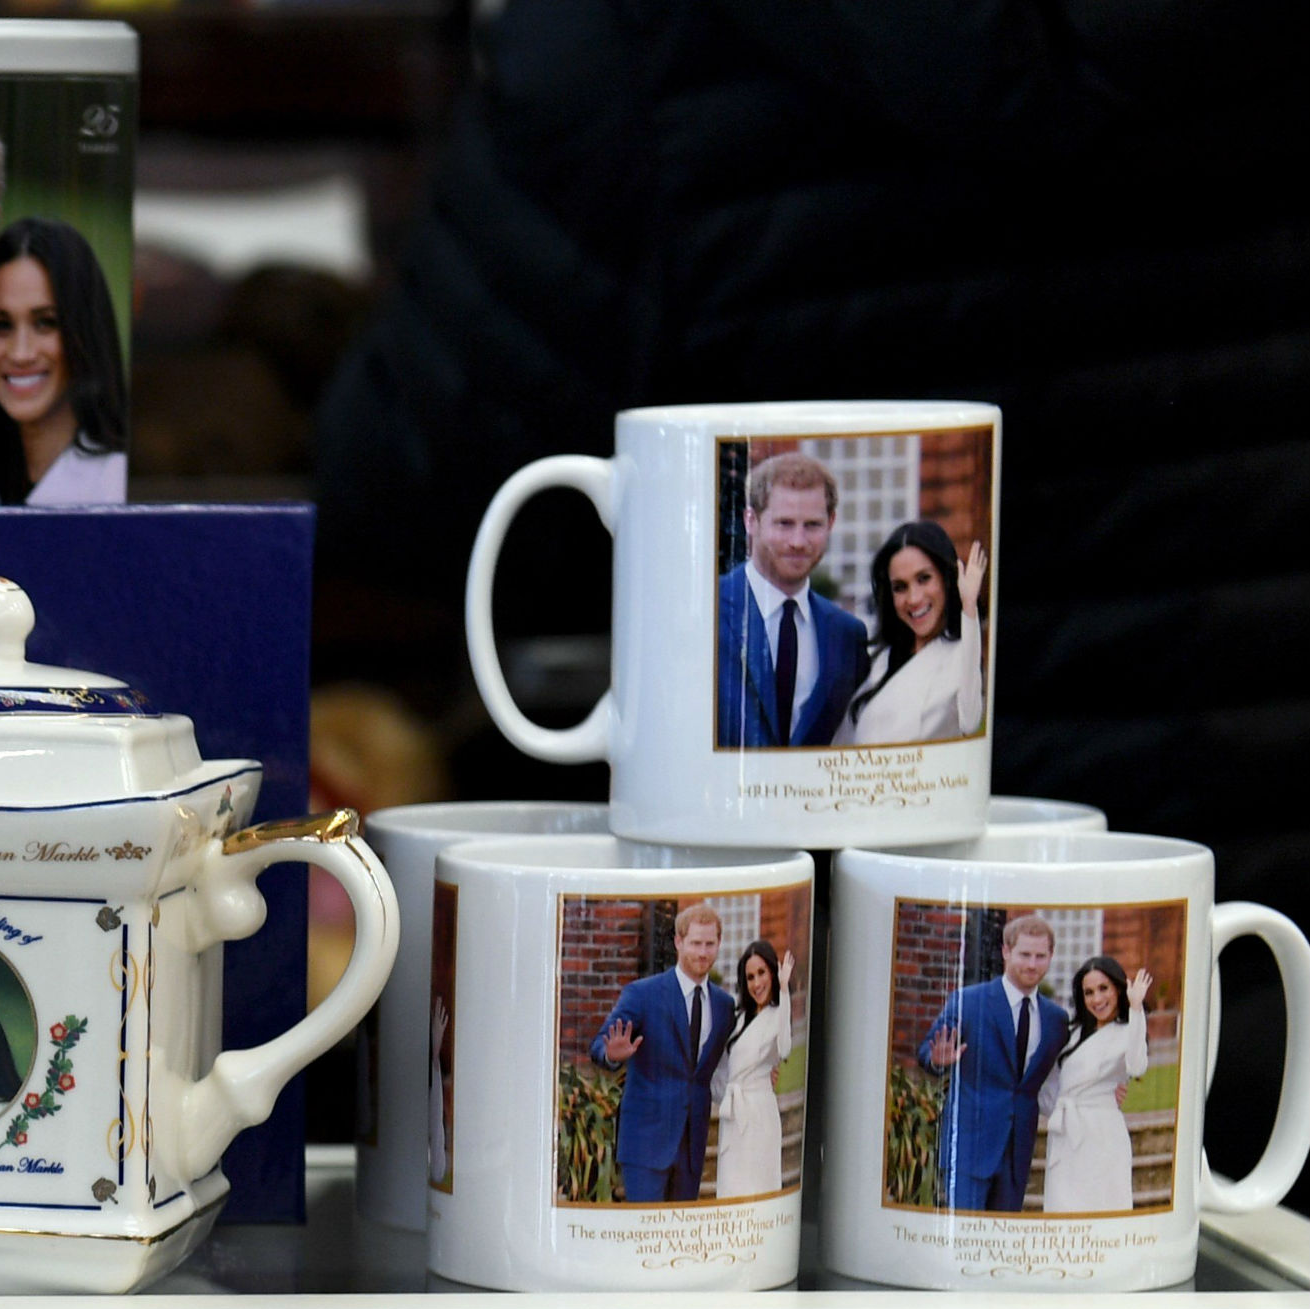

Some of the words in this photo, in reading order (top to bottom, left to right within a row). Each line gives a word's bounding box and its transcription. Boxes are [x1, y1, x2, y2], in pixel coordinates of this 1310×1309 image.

[22, 840, 100, 863] Markle
[991, 1219, 1064, 1234] November
[1067, 1223, 1094, 1236] 2017
